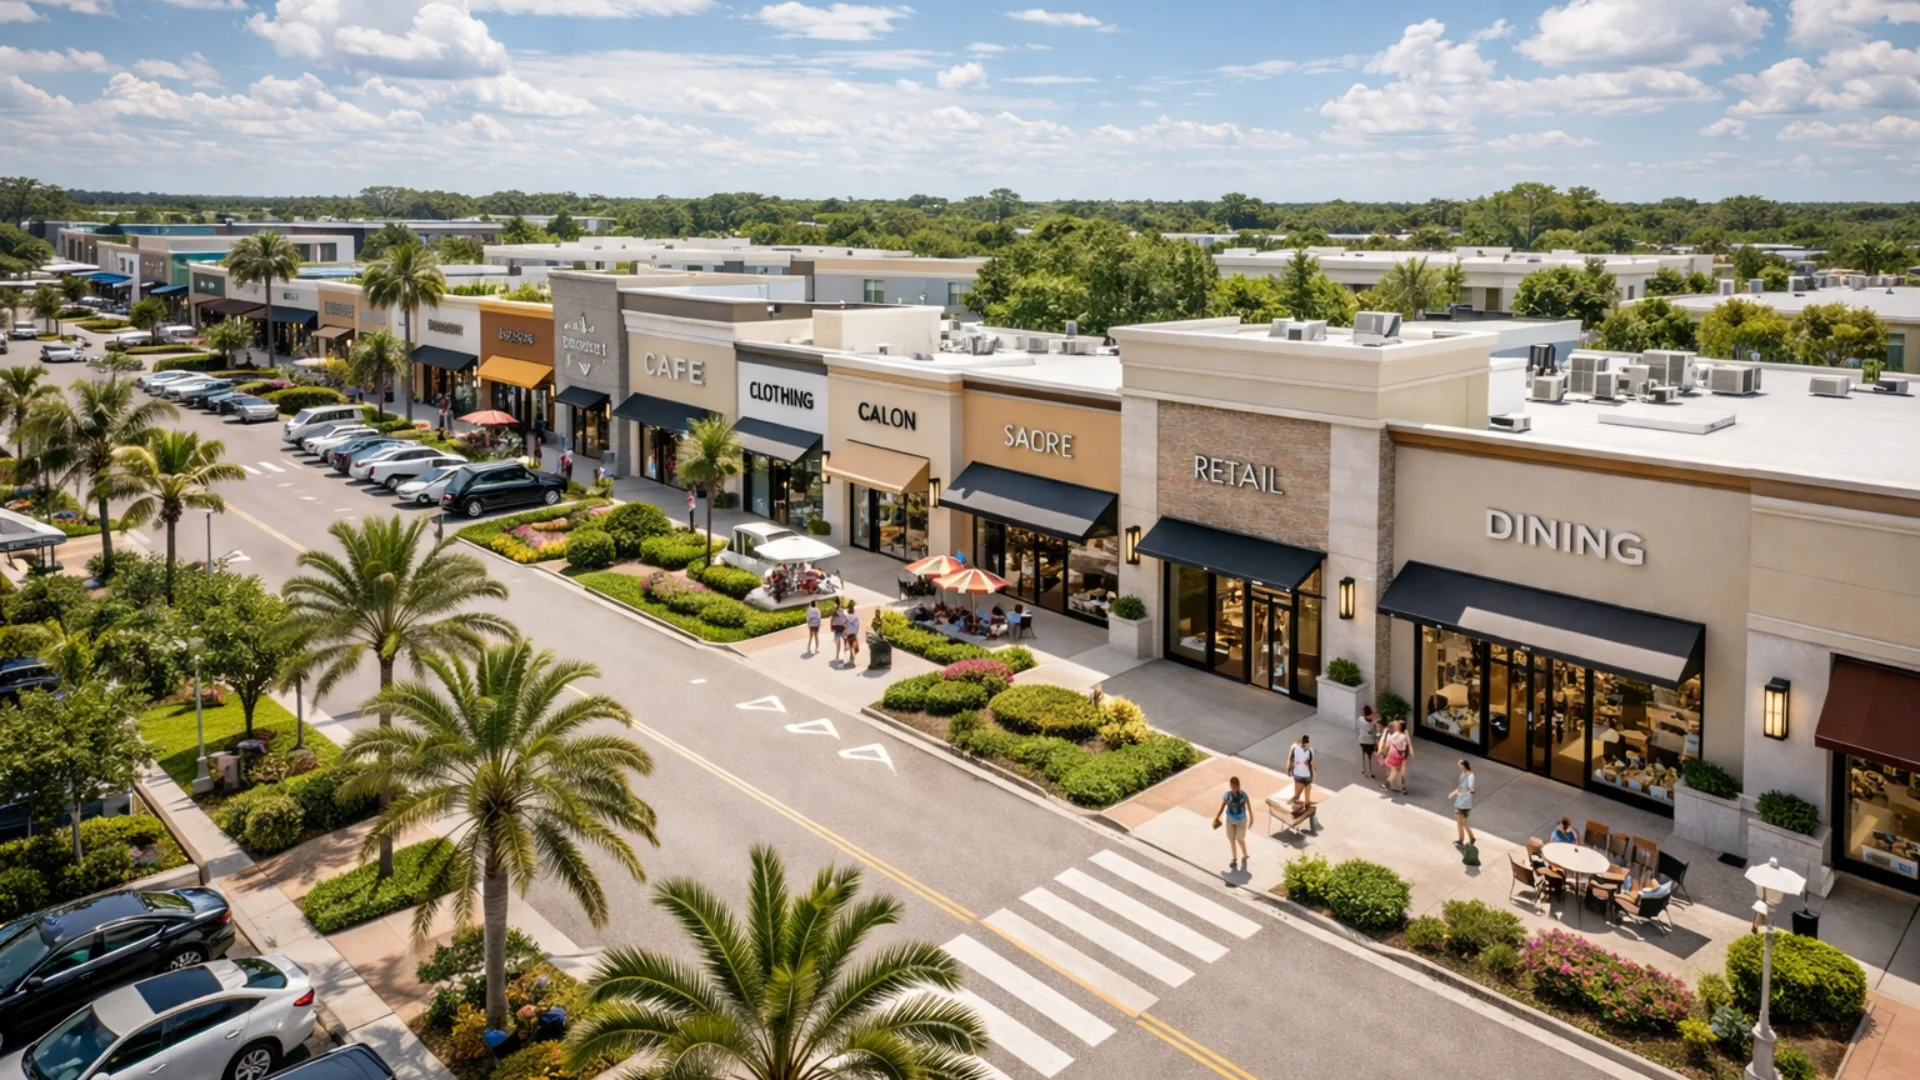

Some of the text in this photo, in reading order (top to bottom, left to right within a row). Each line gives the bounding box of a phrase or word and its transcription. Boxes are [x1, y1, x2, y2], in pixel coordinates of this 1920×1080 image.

[644, 352, 706, 386] CAFE
[750, 381, 814, 410] CLOTHING
[858, 402, 917, 431] CALON
[1194, 454, 1284, 495] RETAIL
[1485, 508, 1645, 566] DINING
